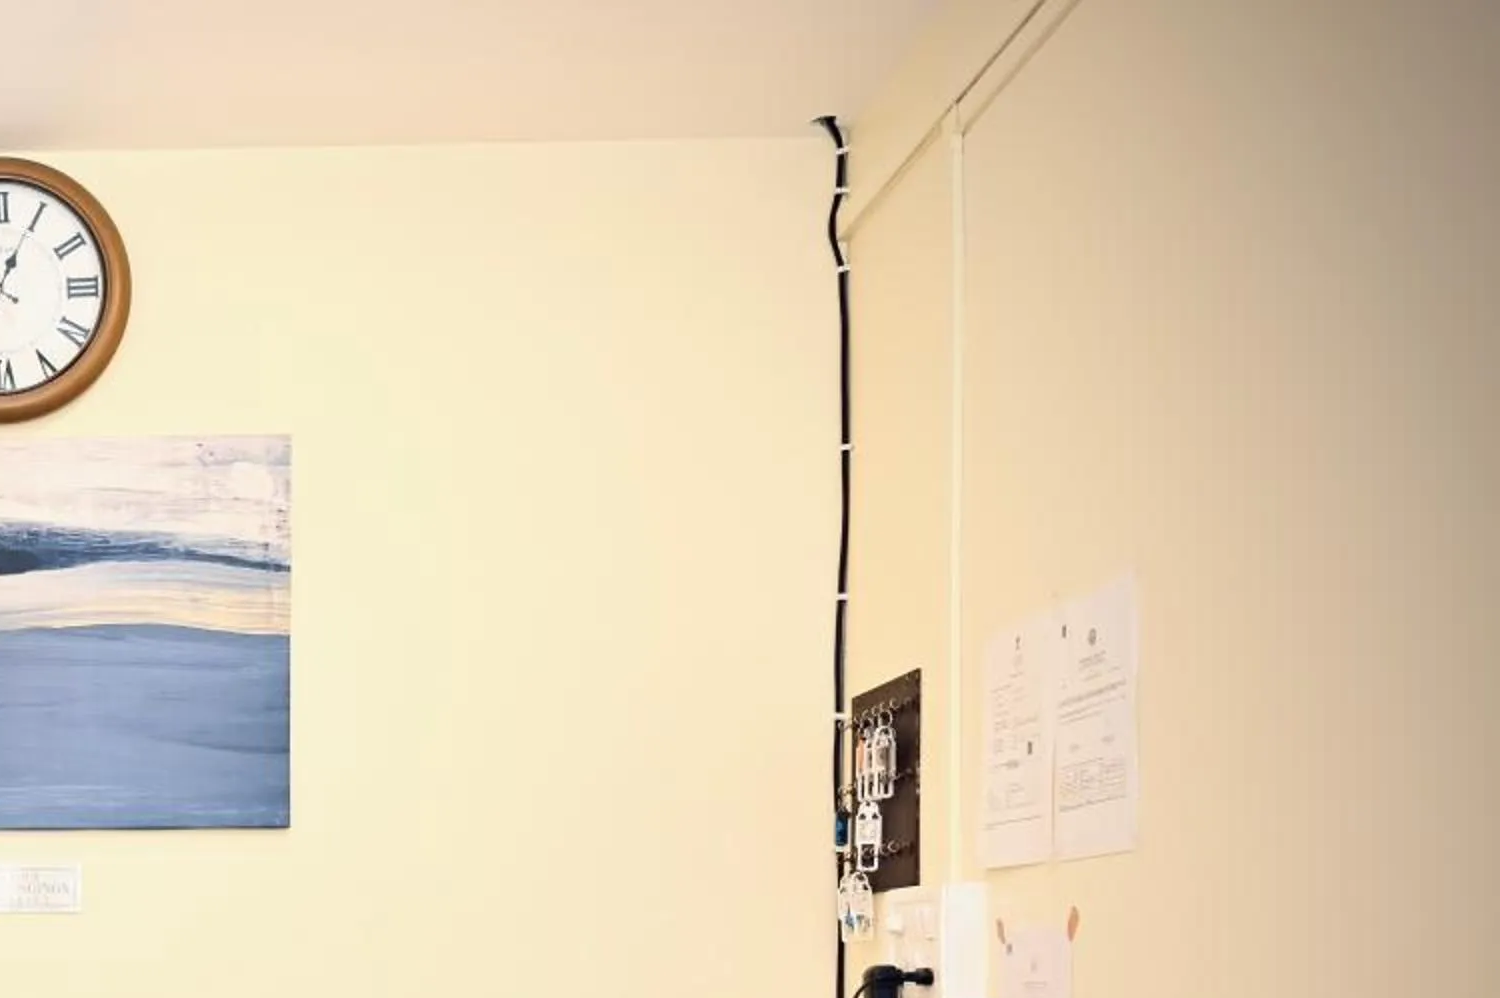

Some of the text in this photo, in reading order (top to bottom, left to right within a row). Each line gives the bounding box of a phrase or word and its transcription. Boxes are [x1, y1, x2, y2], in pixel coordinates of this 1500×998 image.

[53, 232, 87, 260] II
[66, 276, 99, 299] III
[56, 316, 90, 348] IV
[35, 348, 59, 380] V
